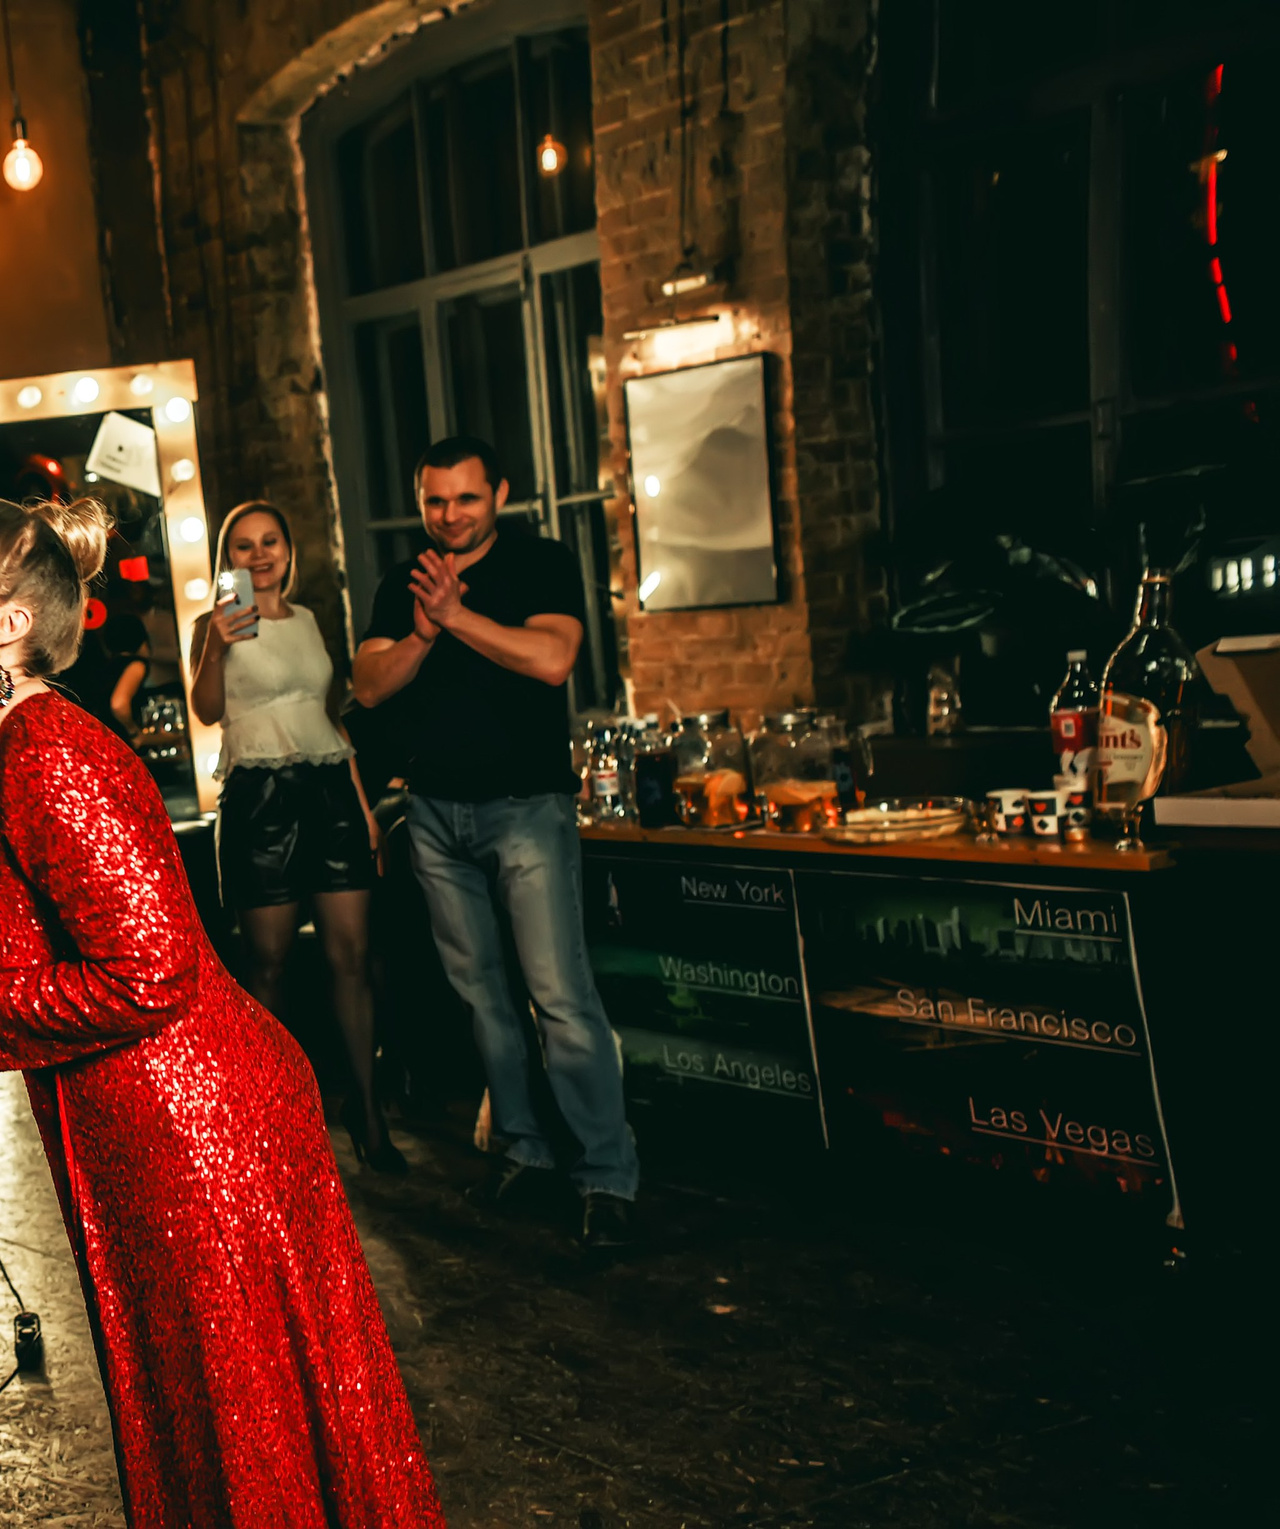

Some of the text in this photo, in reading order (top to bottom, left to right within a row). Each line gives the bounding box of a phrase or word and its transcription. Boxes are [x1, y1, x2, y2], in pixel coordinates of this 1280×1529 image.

[681, 876, 785, 903] New York
[1013, 898, 1118, 933] Miami
[658, 955, 799, 996] Washington
[897, 988, 1137, 1047] San Francisco
[663, 1044, 812, 1093] Los Angeles
[969, 1096, 1155, 1157] Las Vegas
